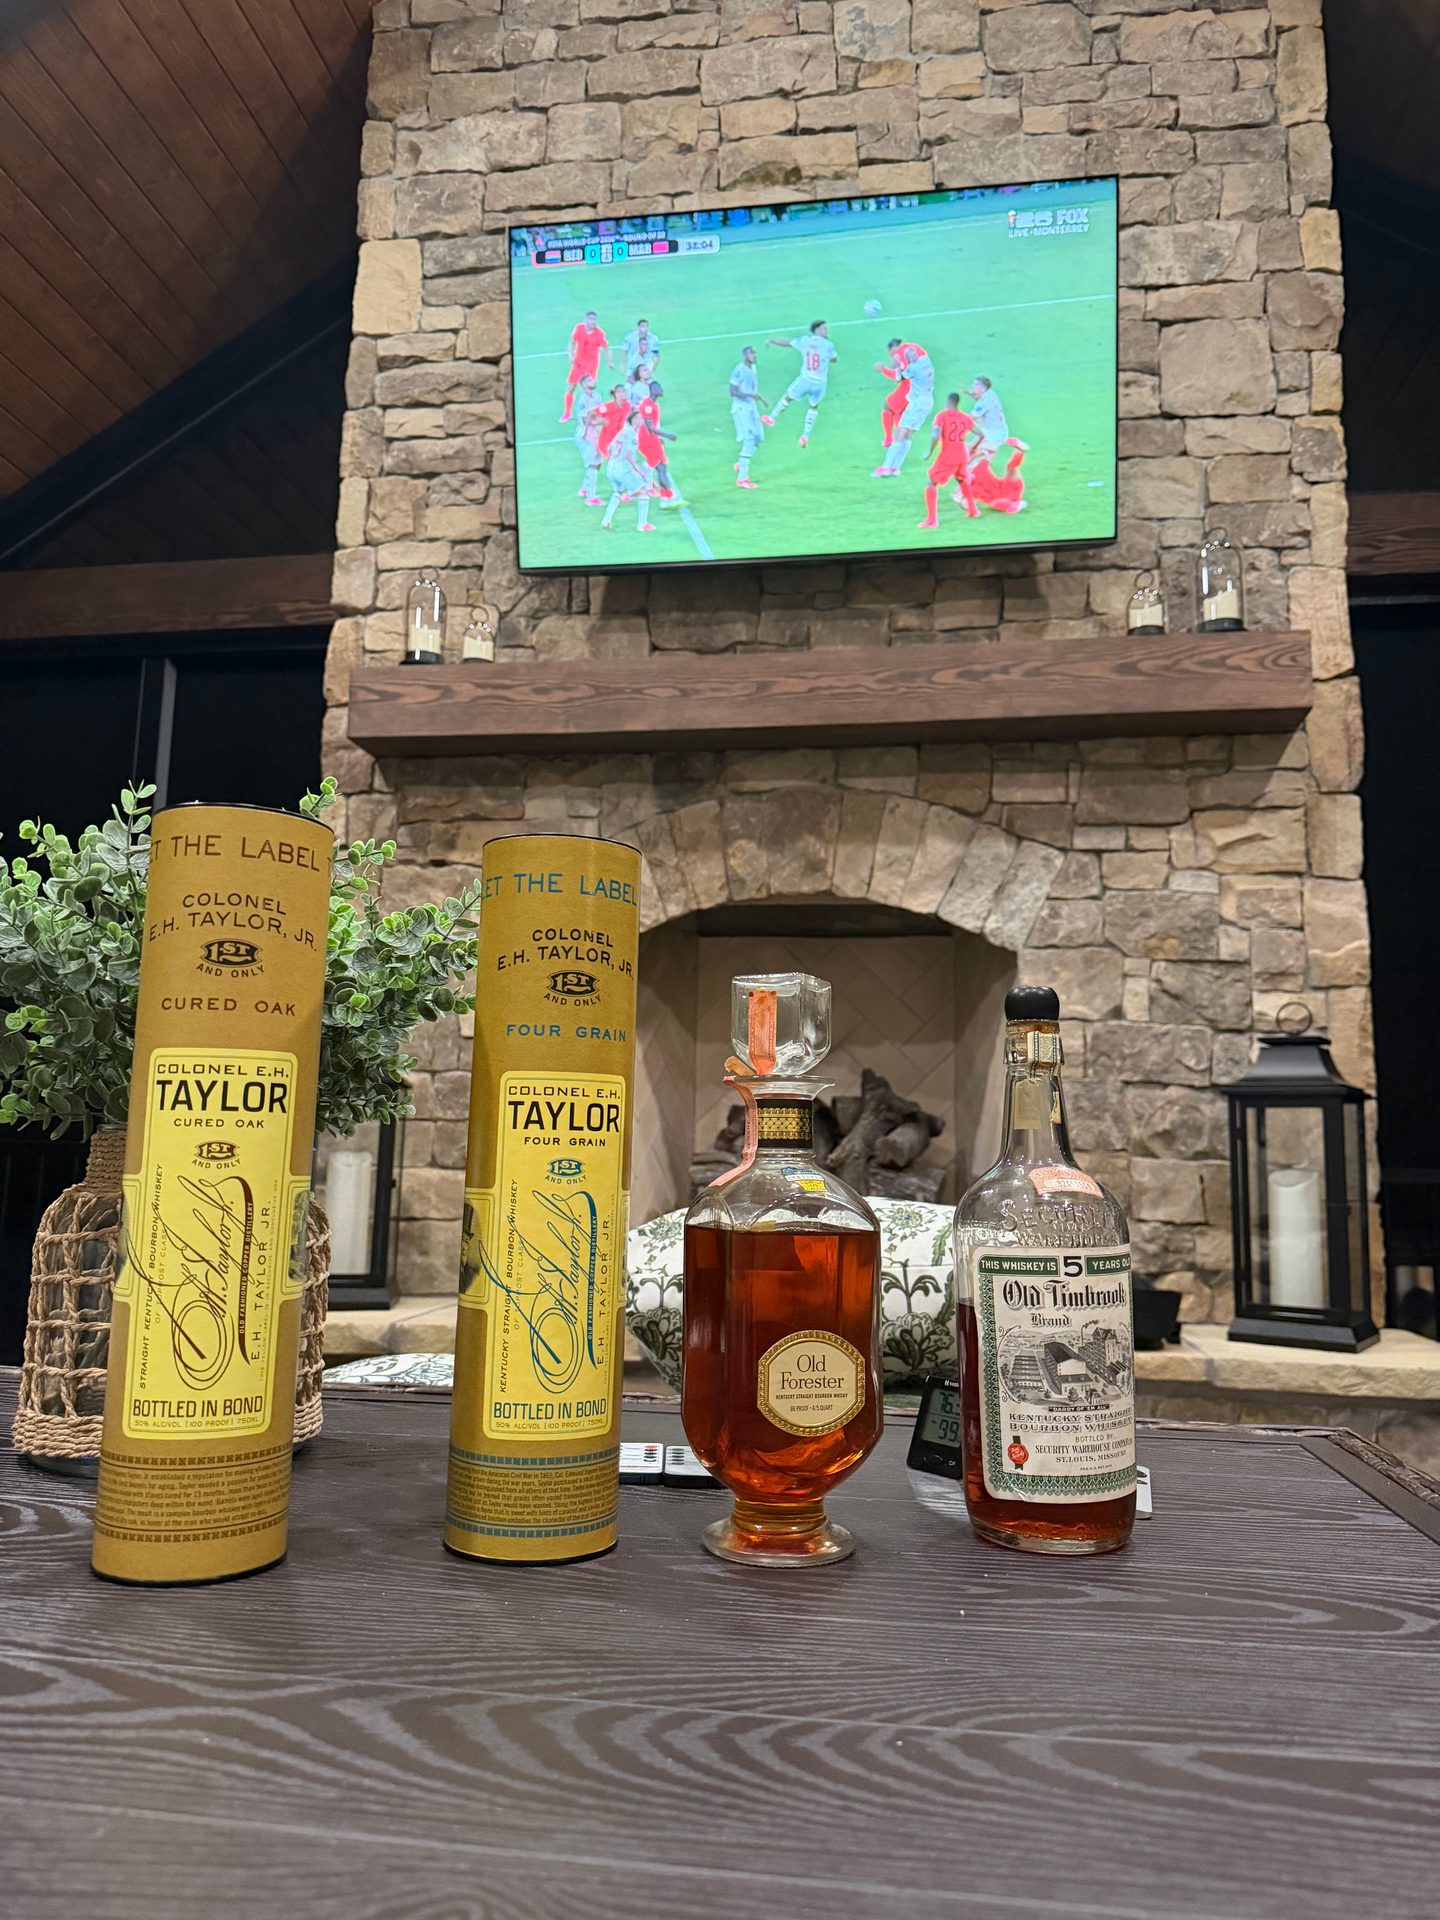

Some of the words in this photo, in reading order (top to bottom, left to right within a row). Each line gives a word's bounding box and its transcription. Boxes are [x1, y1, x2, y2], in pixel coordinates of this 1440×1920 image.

[1056, 208, 1089, 225] FOX
[806, 351, 820, 371] 18
[171, 835, 221, 857] THE
[241, 837, 320, 872] LABEL
[513, 873, 563, 893] THE
[580, 875, 637, 906] LABEL
[182, 892, 287, 915] COLONEL
[149, 917, 180, 941] E.H.
[188, 912, 287, 938] TAYLOR,
[294, 928, 317, 951] JR.
[532, 928, 614, 948] COLONEL
[196, 963, 223, 977] AND
[231, 965, 265, 978] ONLY
[497, 950, 530, 971] E.H.
[537, 946, 615, 970] TAYLOR,
[618, 959, 634, 980] JR.
[161, 998, 237, 1011] CURED
[255, 1000, 295, 1016] OAK
[544, 993, 567, 1006] AND
[574, 994, 601, 1007] ONLY
[507, 1024, 561, 1037] FOUR
[576, 1026, 626, 1042] GRAIN
[157, 1064, 248, 1075] COLONEL
[256, 1066, 289, 1078] E.H.
[156, 1080, 287, 1114] TAYLOR
[508, 1086, 590, 1098] COLONEL
[596, 1089, 621, 1099] E.H.
[173, 1118, 224, 1128] CURED
[235, 1119, 264, 1128] OAK
[508, 1101, 620, 1132] TAYLOR
[524, 1137, 561, 1146] FOUR
[569, 1137, 606, 1147] GRAIN
[191, 1159, 211, 1169] AND
[216, 1158, 241, 1170] ONLY
[153, 1164, 163, 1210] WHISKEY
[544, 1175, 562, 1185] AND
[566, 1175, 587, 1185] ONLY
[508, 1179, 518, 1223] WHISKEY
[245, 1202, 253, 1242] DISTILLERY
[261, 1201, 271, 1229] JR.
[149, 1216, 159, 1269] BOURBON
[506, 1229, 515, 1278] BOURBON
[242, 1245, 250, 1273] COPPER
[981, 1260, 1000, 1270] THIS
[1002, 1260, 1045, 1271] WHISKEY
[1046, 1262, 1057, 1271] IS
[1063, 1255, 1084, 1277] 5
[1092, 1259, 1120, 1270] YEARS
[254, 1242, 268, 1311] TAYLOR
[599, 1253, 608, 1318] TAYLOR
[240, 1276, 248, 1317] FASHIONED
[1003, 1279, 1044, 1310] Old
[1043, 1279, 1127, 1309] Timbrook
[1029, 1313, 1072, 1328] Brand
[251, 1324, 262, 1360] E.H.
[140, 1336, 150, 1390] STRAIGHT
[500, 1339, 509, 1393] KENTUCKY
[797, 1354, 826, 1372] Old
[780, 1371, 845, 1390] Forester
[133, 1399, 197, 1418] BOTTLED
[201, 1400, 217, 1417] IN
[223, 1395, 263, 1416] BOND
[494, 1402, 554, 1420] BOTTLED
[558, 1402, 572, 1419] IN
[576, 1398, 606, 1418] BOND
[1009, 1413, 1081, 1424] KENTUCKY
[1084, 1407, 1133, 1421] STRAIGHT
[1009, 1422, 1082, 1434] BOURBON
[1084, 1417, 1133, 1432] WHISKEY
[1035, 1444, 1069, 1454] SECURITY
[1072, 1443, 1110, 1454] WAREHOUSE
[1075, 1435, 1104, 1443] BOTTLED
[1098, 1450, 1126, 1461] MISSOURI
